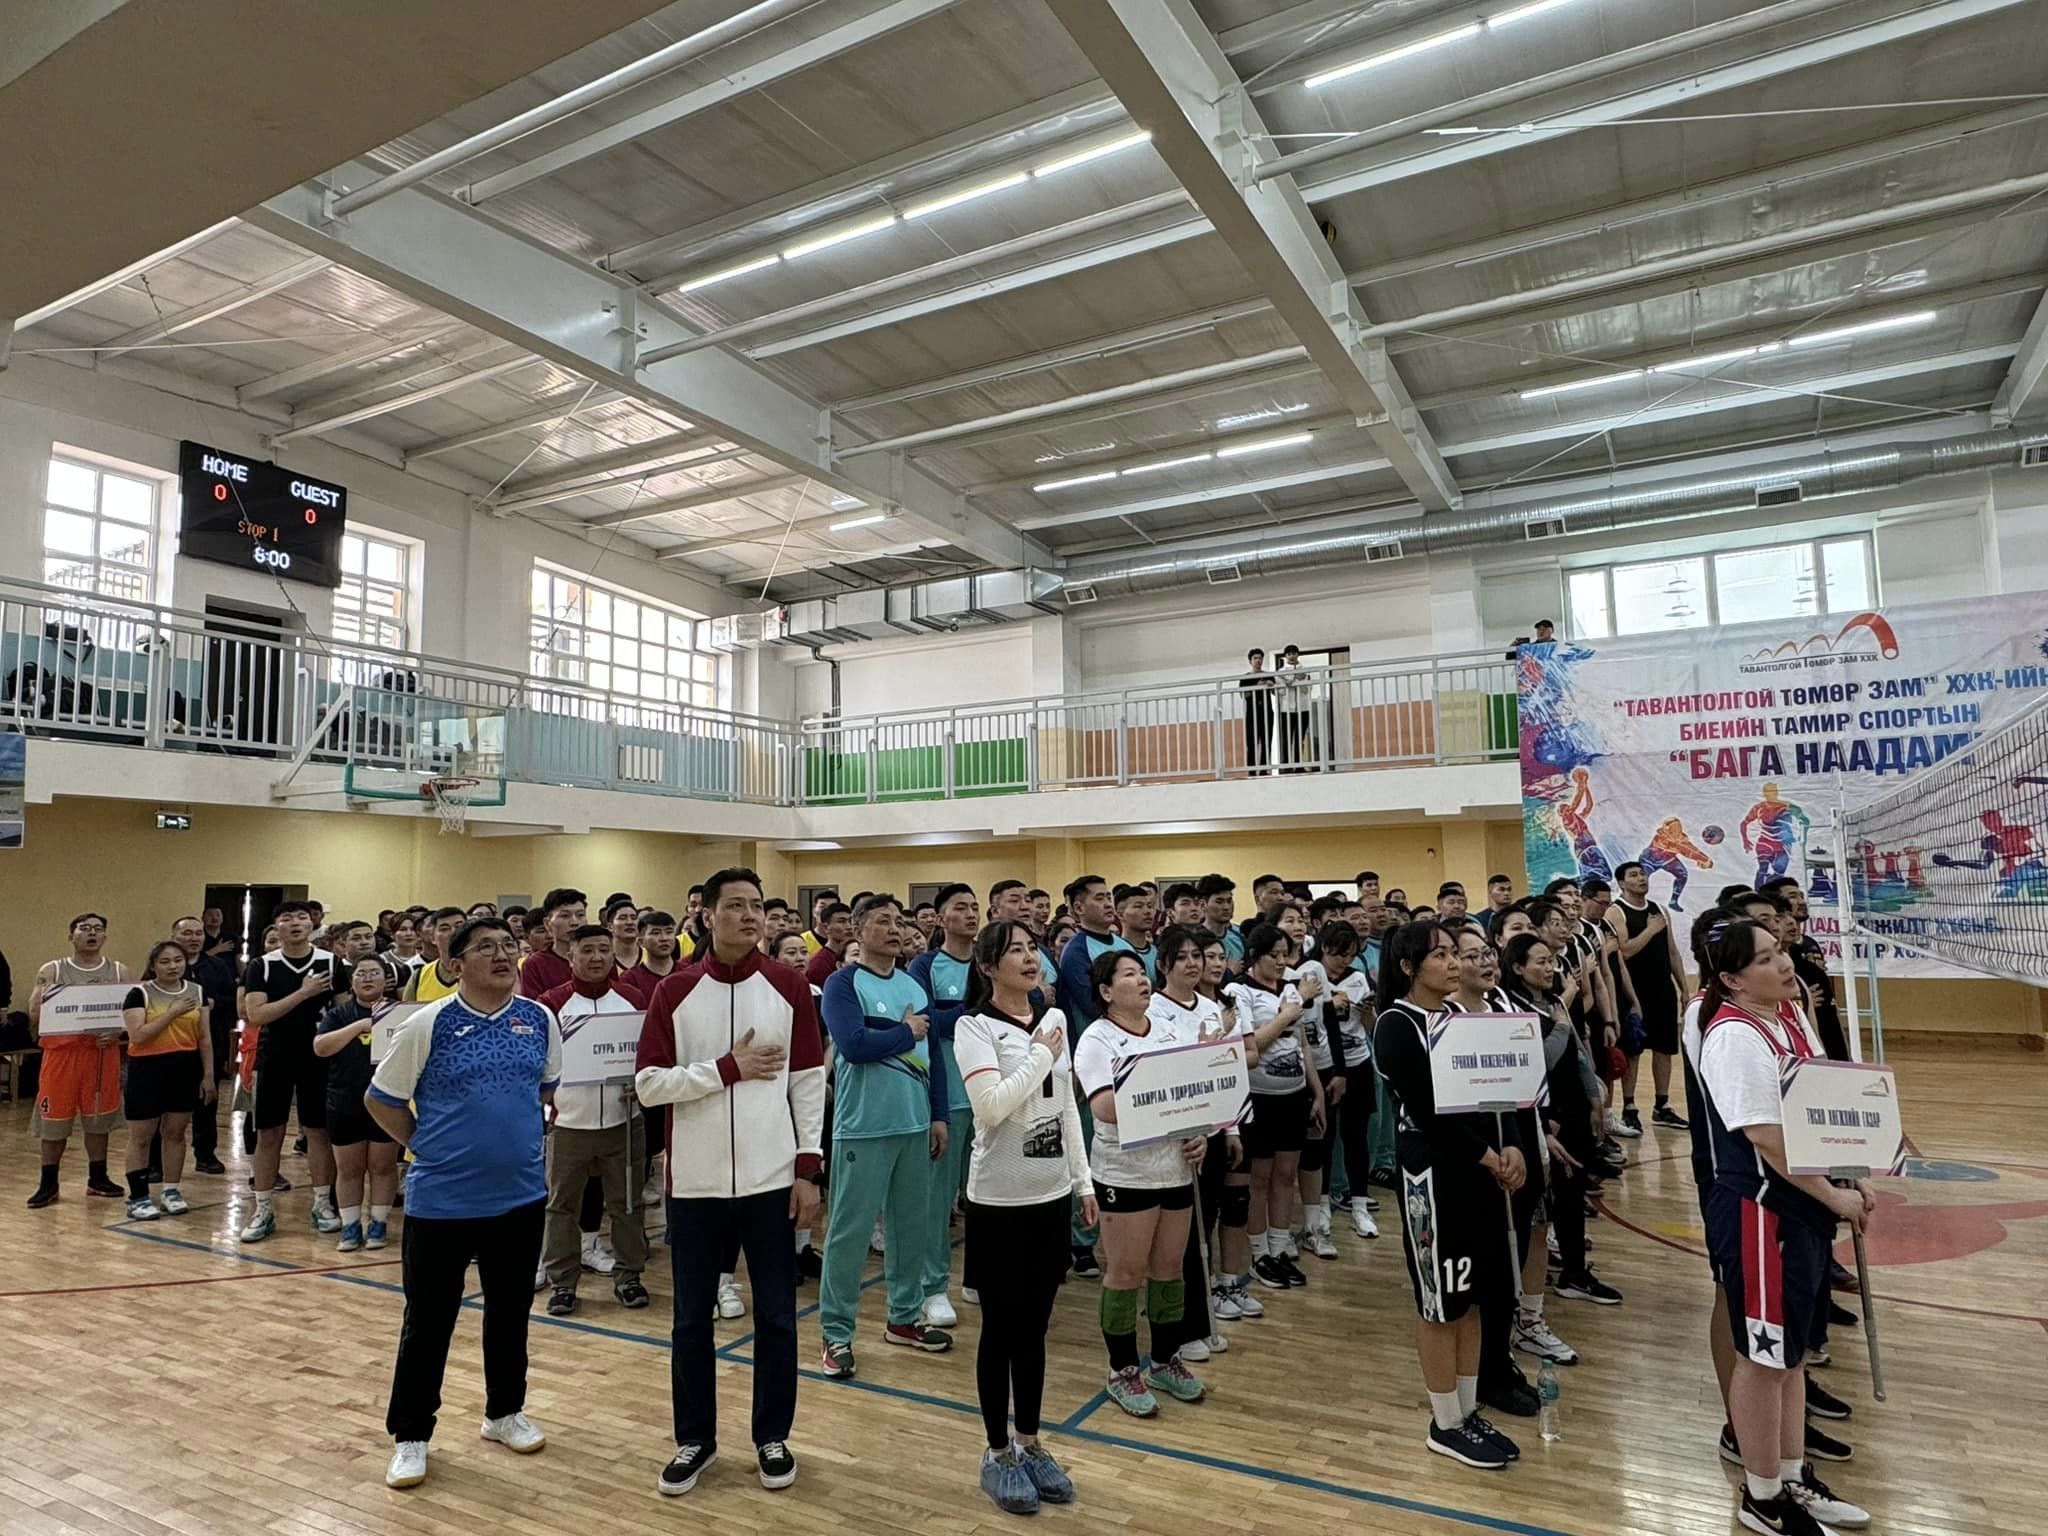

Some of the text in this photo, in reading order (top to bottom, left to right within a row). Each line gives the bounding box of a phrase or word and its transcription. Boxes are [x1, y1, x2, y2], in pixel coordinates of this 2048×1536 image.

[202, 454, 248, 482] HOME
[214, 484, 226, 501] 0
[291, 481, 340, 508] GUEST
[305, 509, 316, 525] 0
[238, 520, 267, 538] STOP
[1838, 655, 1858, 664] ЗАМ
[1860, 654, 1879, 662] ХХК
[1614, 688, 1774, 717] “ТАВАНТОЛГОЙ
[1780, 683, 1859, 706] ТӨМӨР
[1869, 676, 1938, 699] ЗАМ”
[1680, 703, 1979, 741] БИЕИЙН ТАМИР СПОРТЫН
[1670, 745, 1785, 780] “БАГА
[1132, 1075, 1237, 1108] ЗАХИРГАА УДИРДЛАГЫН ГАЗАР
[41, 1096, 49, 1112] 4
[1862, 1111, 1881, 1128] ГАЗАР
[1106, 1188, 1116, 1203] 3
[1443, 1256, 1471, 1293] 12
